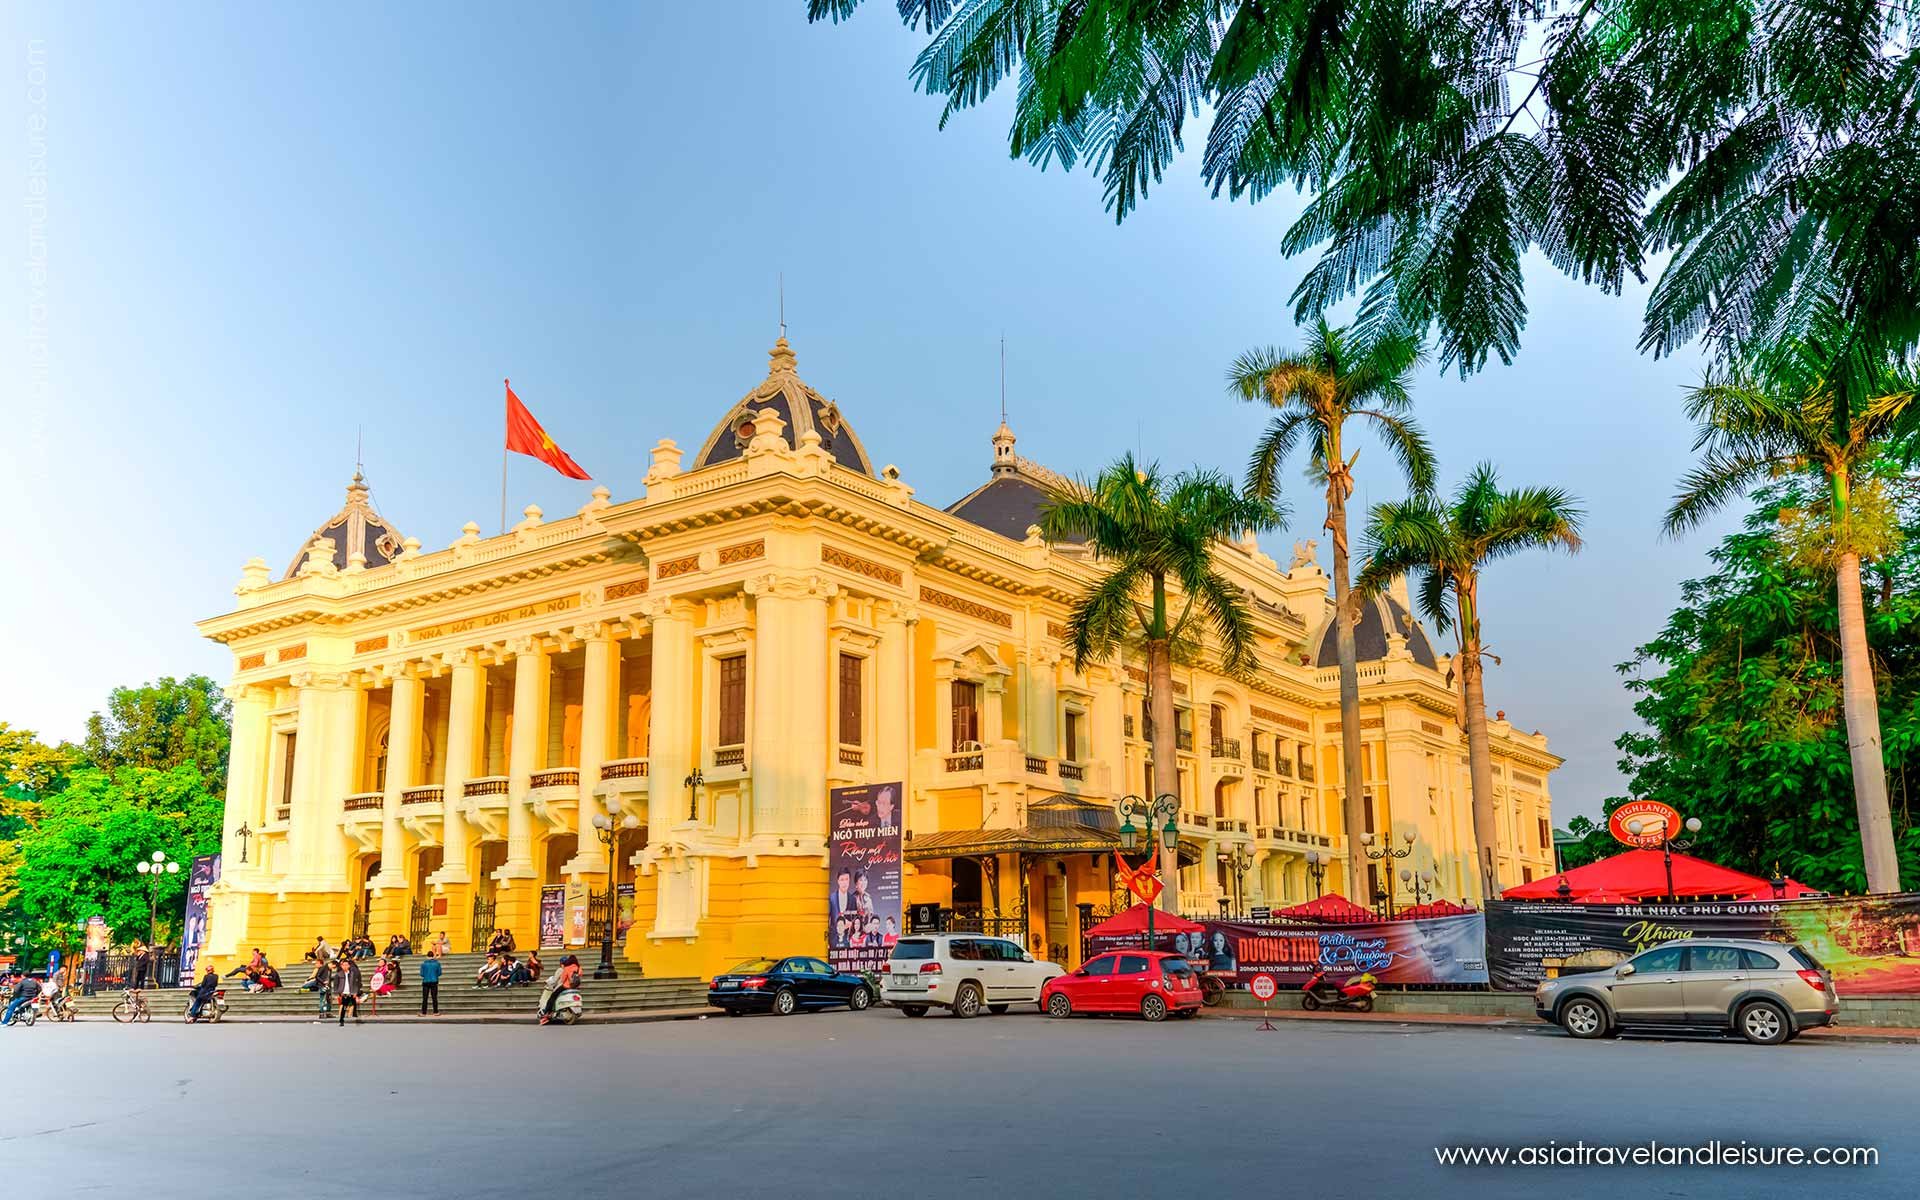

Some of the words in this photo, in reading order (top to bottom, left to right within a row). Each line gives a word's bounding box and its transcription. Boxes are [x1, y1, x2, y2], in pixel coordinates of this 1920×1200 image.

[1615, 804, 1674, 821] HIGHLANDS
[833, 828, 852, 840] NGÔ
[854, 827, 876, 840] THỤY
[877, 824, 899, 836] MIÊN
[1627, 833, 1665, 845] COFFEE
[1616, 905, 1643, 916] ĐÊM
[1650, 906, 1687, 917] NHẠC
[1727, 904, 1780, 914] QUANG
[1238, 937, 1289, 962] DƯƠNG
[1318, 946, 1337, 965] &
